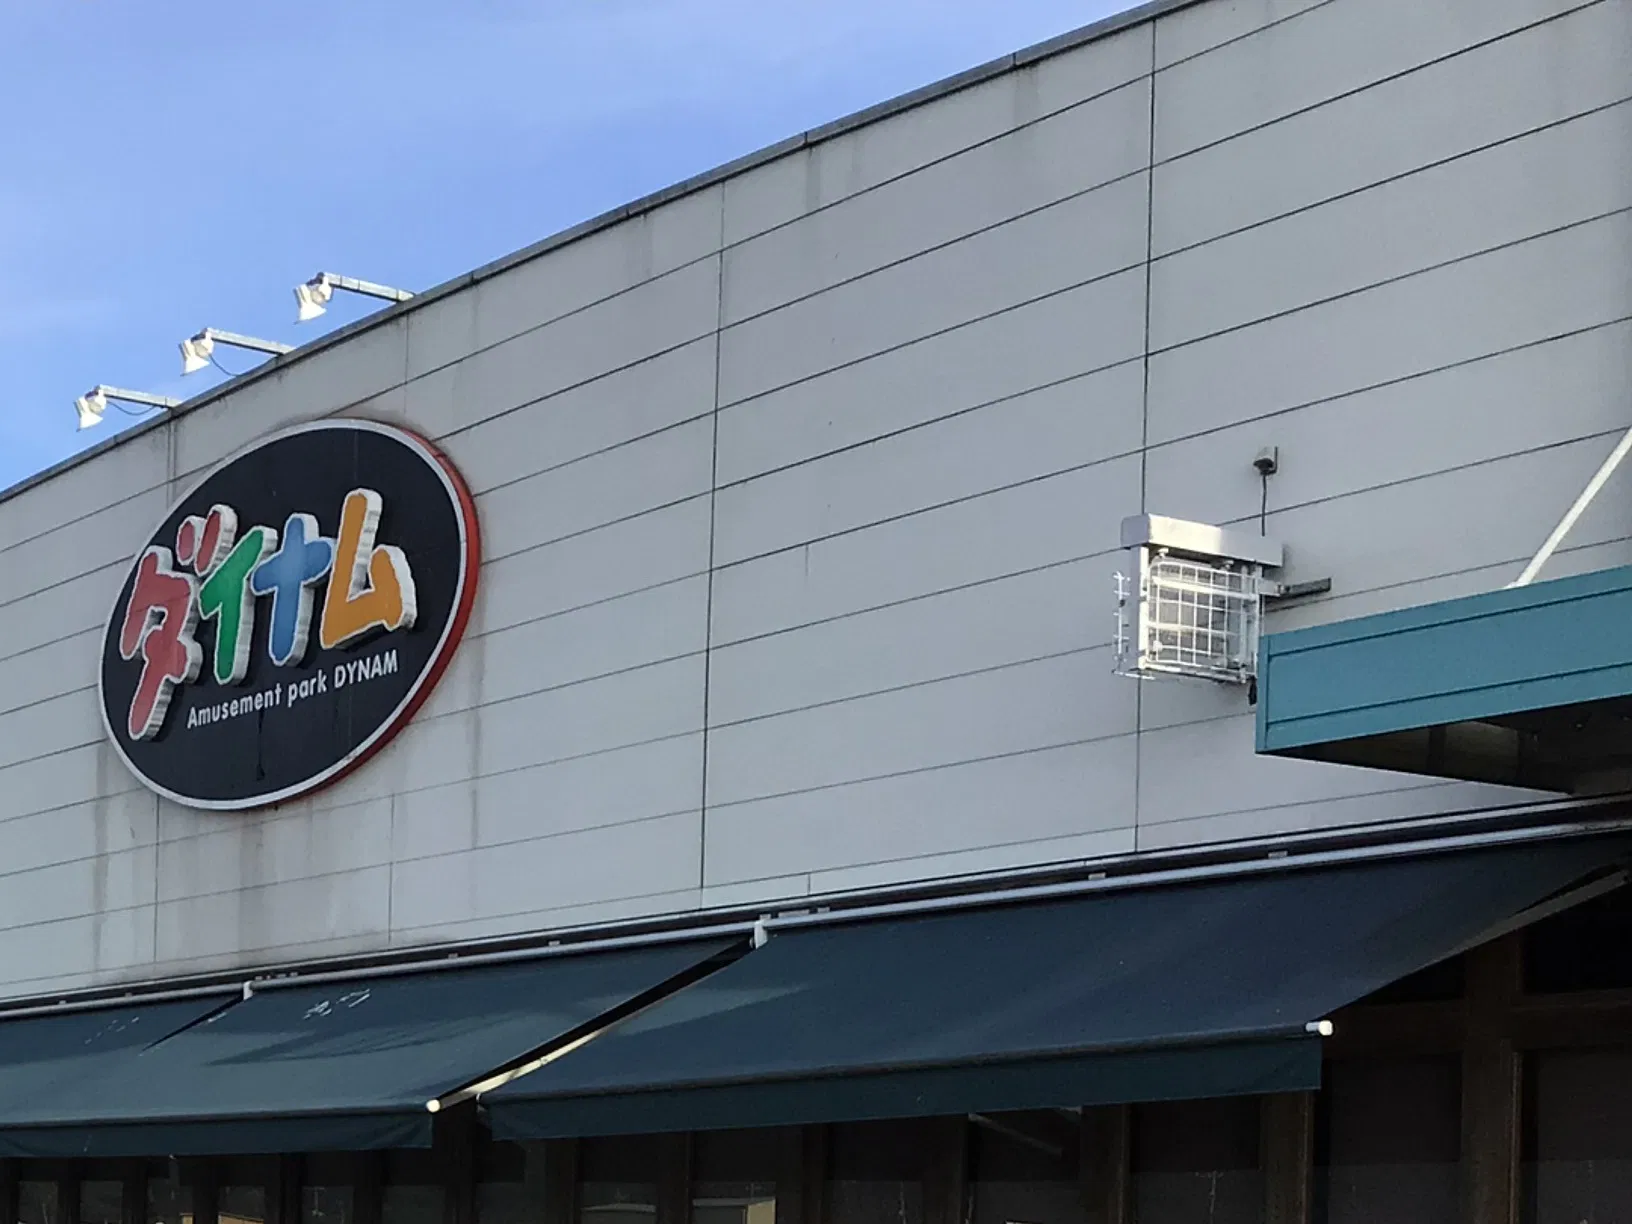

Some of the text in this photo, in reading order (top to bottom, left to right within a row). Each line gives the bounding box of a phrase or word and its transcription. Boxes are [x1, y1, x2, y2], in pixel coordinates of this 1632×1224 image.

[119, 487, 416, 741] ダイナム
[186, 648, 399, 729] Amusement park DYNAM
